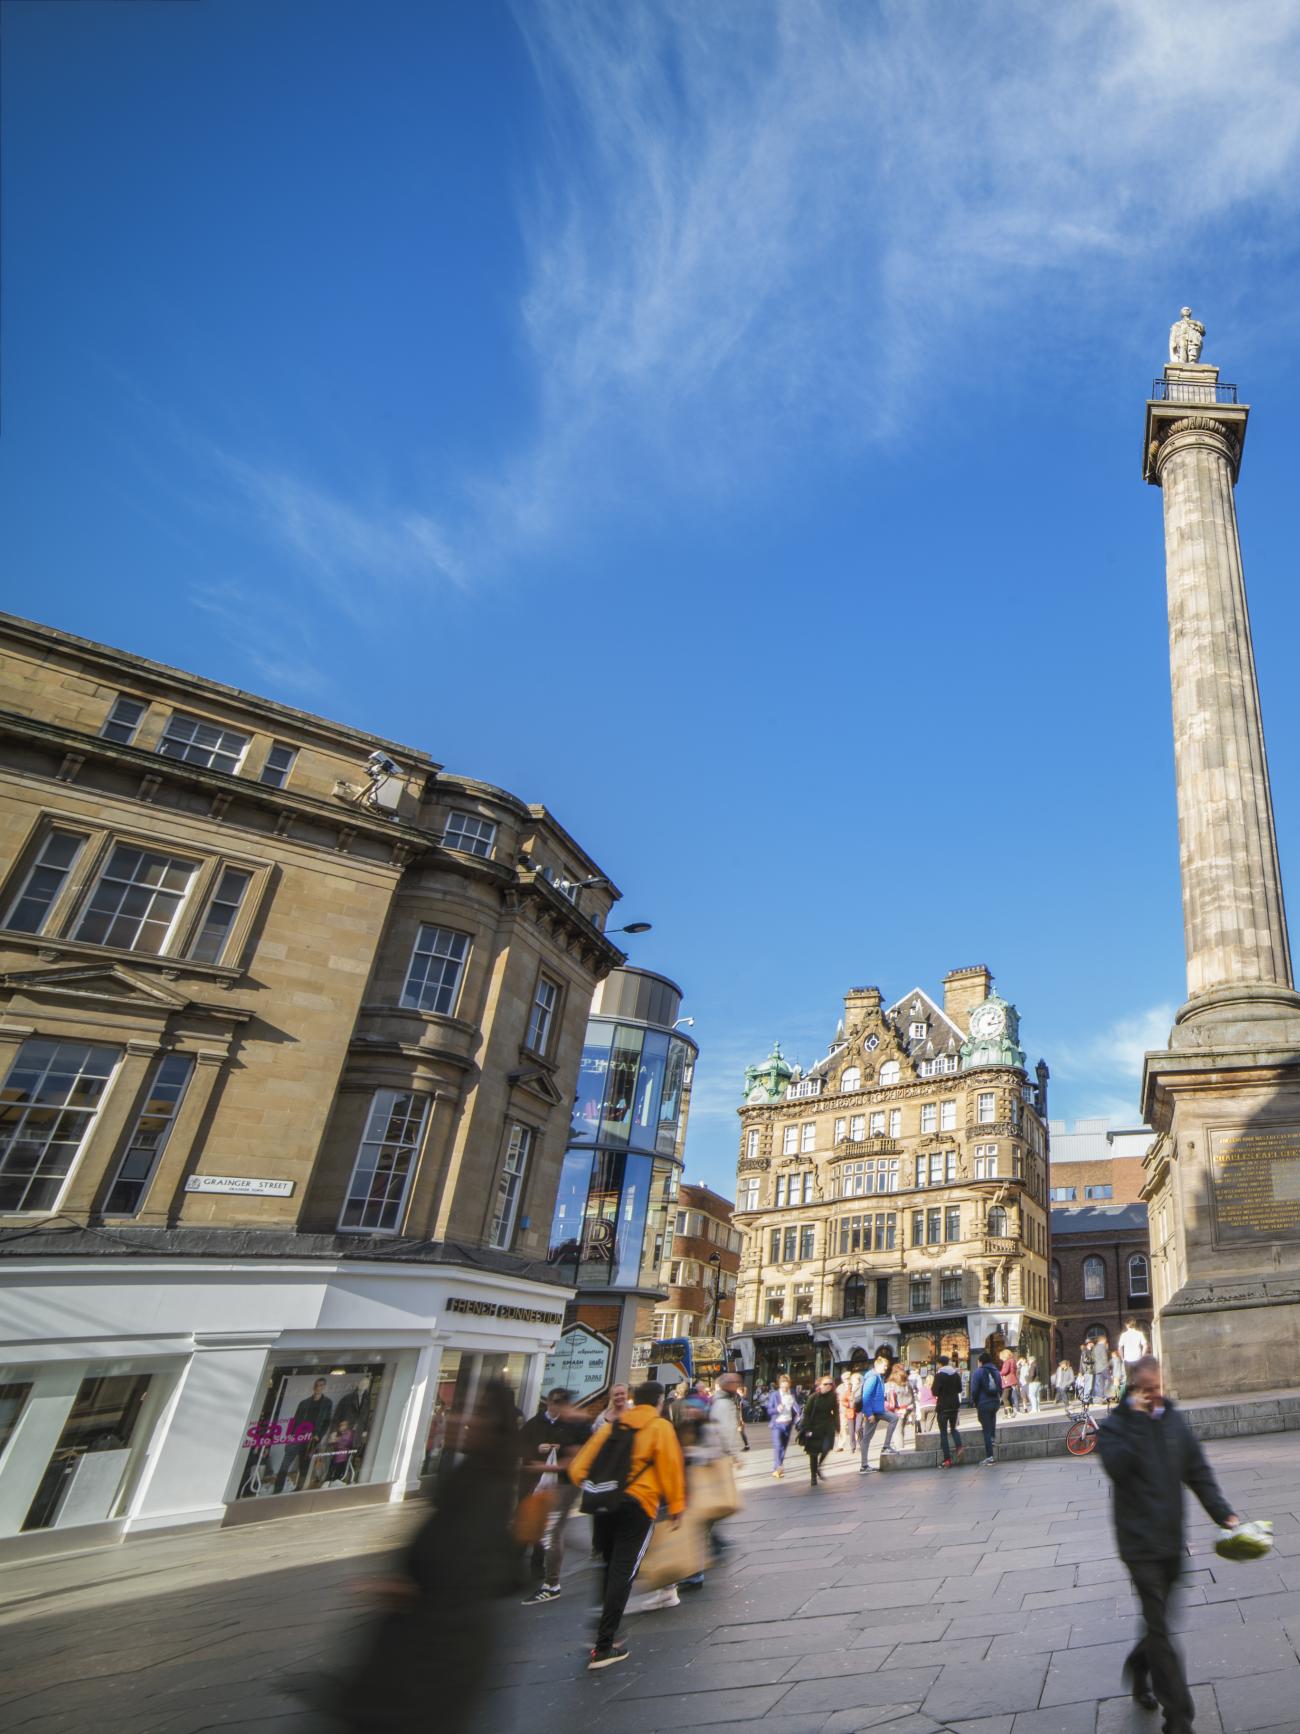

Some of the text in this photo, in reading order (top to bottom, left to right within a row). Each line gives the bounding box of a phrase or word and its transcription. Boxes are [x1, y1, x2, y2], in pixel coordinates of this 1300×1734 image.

[203, 1178, 288, 1190] GRAINGER STREET
[446, 1298, 563, 1325] FRENCH CONNECTION
[243, 1432, 312, 1448] up to 50% off
[246, 1417, 315, 1444] sale
